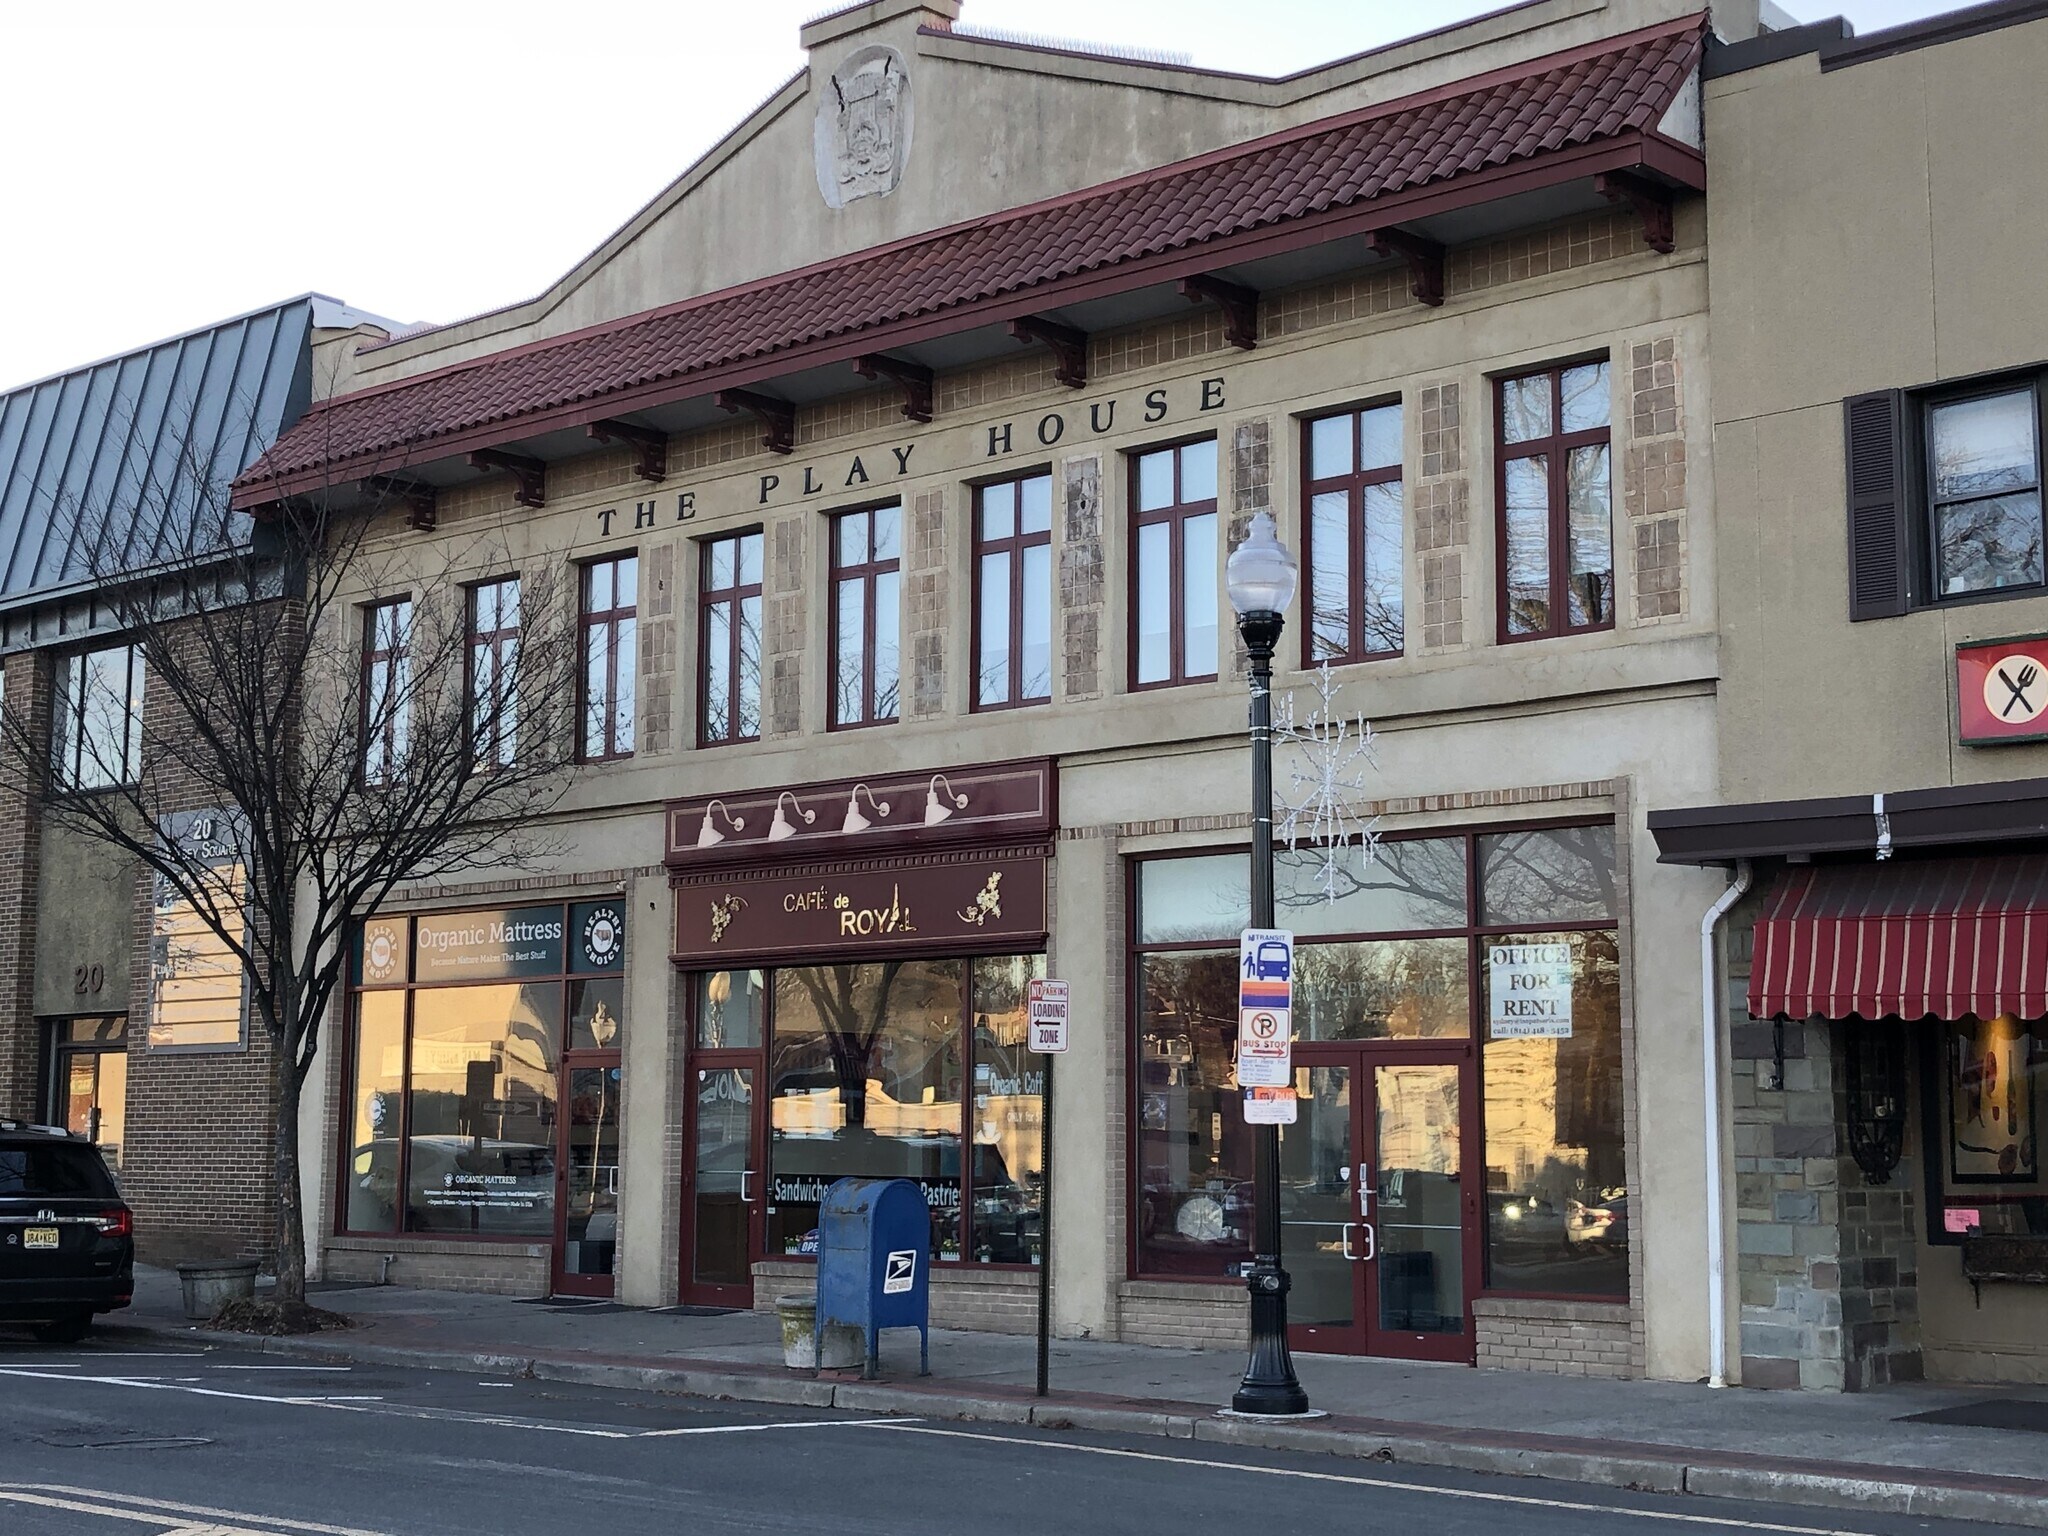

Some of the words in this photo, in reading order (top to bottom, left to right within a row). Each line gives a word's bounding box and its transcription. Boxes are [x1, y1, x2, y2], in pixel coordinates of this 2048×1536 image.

[597, 491, 697, 536] THE
[759, 444, 915, 504] PLAY
[987, 377, 1226, 457] HOUSE
[193, 818, 212, 841] 20
[833, 893, 850, 909] de
[840, 882, 917, 936] ROYAL
[584, 908, 622, 937] HEALTHY
[364, 925, 398, 952] HEALTHY
[418, 925, 485, 953] Organic
[488, 921, 562, 944] Mattress
[457, 954, 479, 965] Nature
[480, 954, 501, 964] Makes
[501, 952, 515, 962] The
[515, 951, 530, 961] Best
[530, 949, 547, 960] Stuff
[584, 942, 621, 965] CHOICE
[1493, 947, 1568, 965] OFFICE
[74, 962, 104, 994] 20
[365, 957, 397, 979] CHOICE
[1031, 984, 1042, 998] NO
[1510, 973, 1551, 990] FOR
[1033, 1003, 1065, 1018] LOADING
[1503, 999, 1559, 1016] RENT
[1039, 1030, 1059, 1043] ZONE
[1242, 1040, 1260, 1048] BUS
[1264, 1041, 1286, 1049] STOP
[990, 1072, 1021, 1096] Organic
[455, 1175, 484, 1184] ORGANIC
[484, 1175, 517, 1185] MATTRESS
[775, 1177, 830, 1202] Sandwiche
[801, 1241, 819, 1252] OPE
